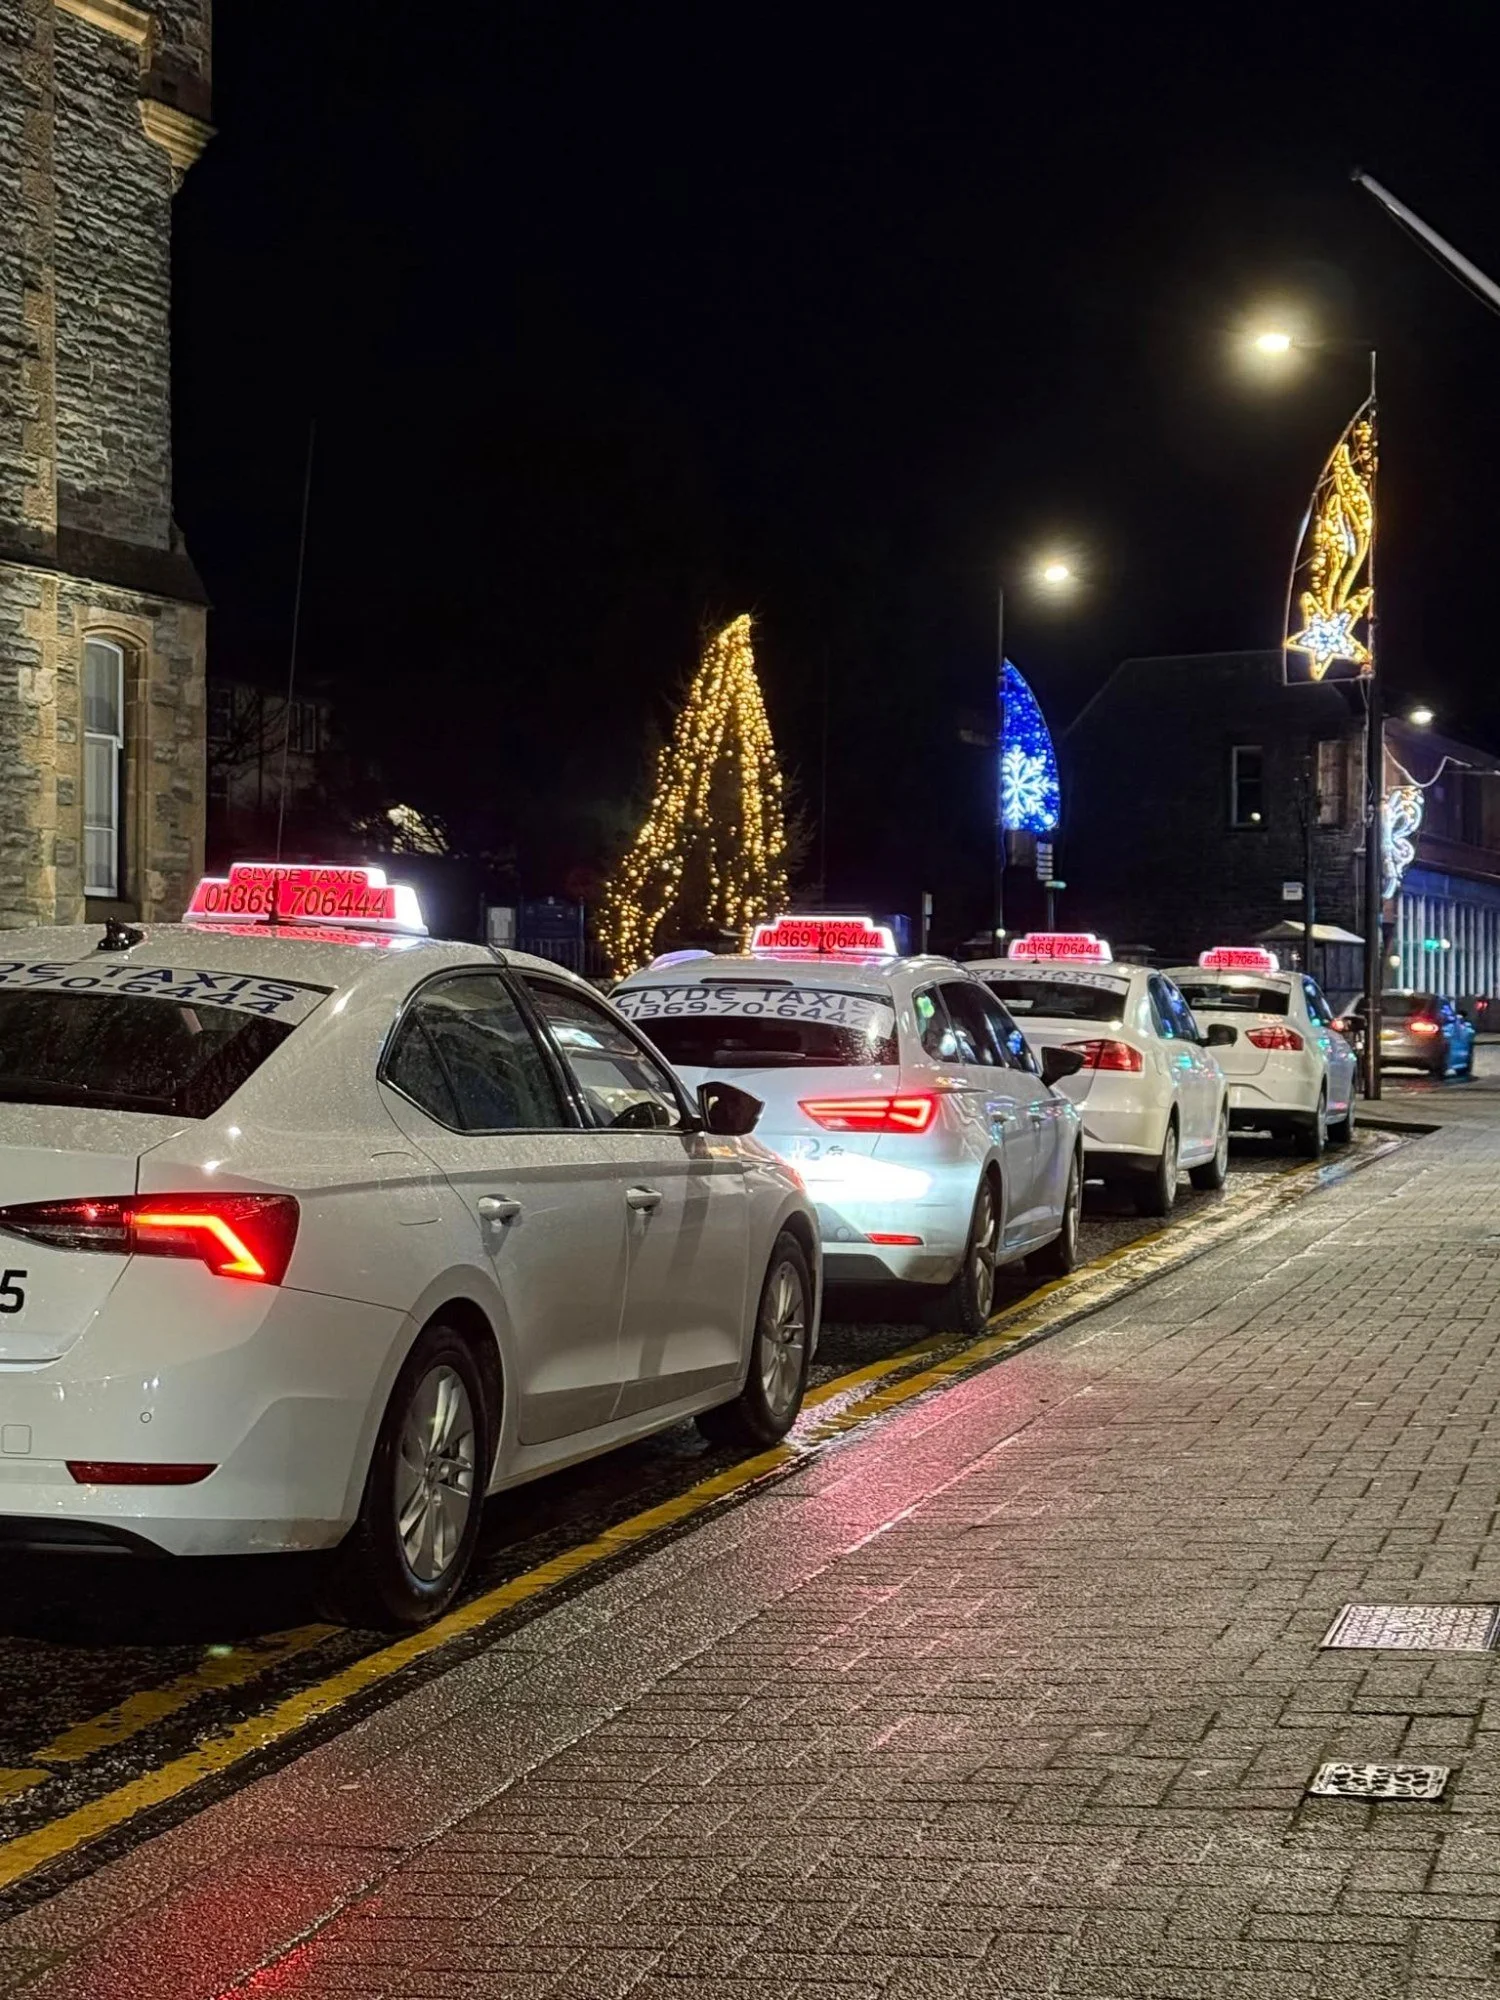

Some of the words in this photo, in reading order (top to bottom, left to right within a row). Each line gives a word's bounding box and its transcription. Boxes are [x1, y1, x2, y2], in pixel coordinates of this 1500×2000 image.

[236, 866, 301, 883] CLYDE
[308, 868, 369, 885] TAXIS
[204, 883, 279, 914] 01369
[290, 885, 388, 918] 706444
[761, 929, 811, 948] 01369
[818, 930, 879, 949] 706444
[0, 974, 284, 1016] -70-6444
[103, 964, 302, 1003] TAXIS
[615, 987, 738, 1009] CLYDE
